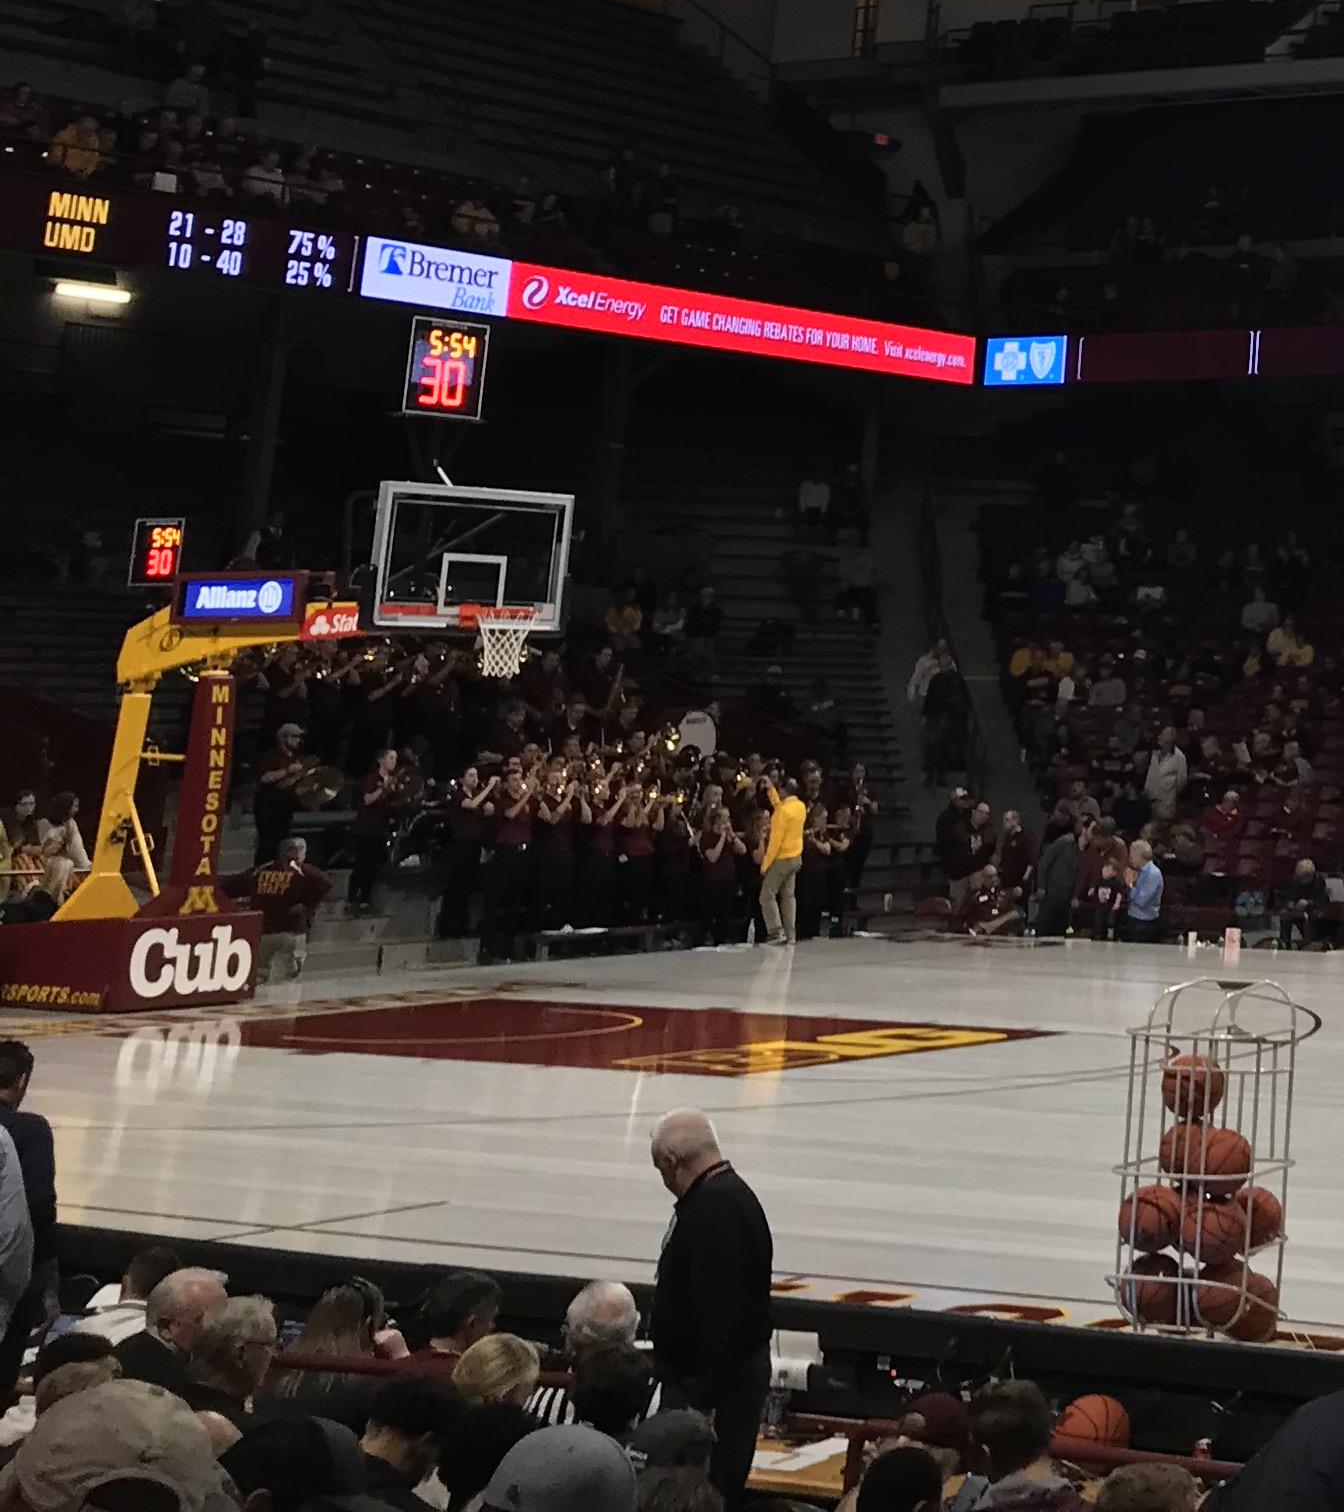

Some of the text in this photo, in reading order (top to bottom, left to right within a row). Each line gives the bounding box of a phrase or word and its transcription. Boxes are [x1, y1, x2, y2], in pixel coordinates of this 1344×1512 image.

[47, 190, 336, 261] MINN 21 28 75%
[43, 221, 332, 288] UMD 10 40 25%
[406, 248, 499, 289] Bremer
[450, 285, 496, 313] Bank
[428, 328, 476, 360] 5:54
[660, 304, 680, 324] GET
[681, 308, 711, 330] GAME
[712, 313, 761, 337] CHANGING
[764, 320, 804, 343] REBATES
[806, 328, 824, 345] FOR
[825, 330, 850, 349] YOUR
[884, 340, 903, 359] Visit
[418, 357, 465, 408] 30
[152, 528, 181, 548] 5:54
[147, 549, 173, 575] 30
[196, 586, 257, 609] Allianz
[194, 684, 231, 877] MINNESOTA
[129, 925, 252, 998] Cub
